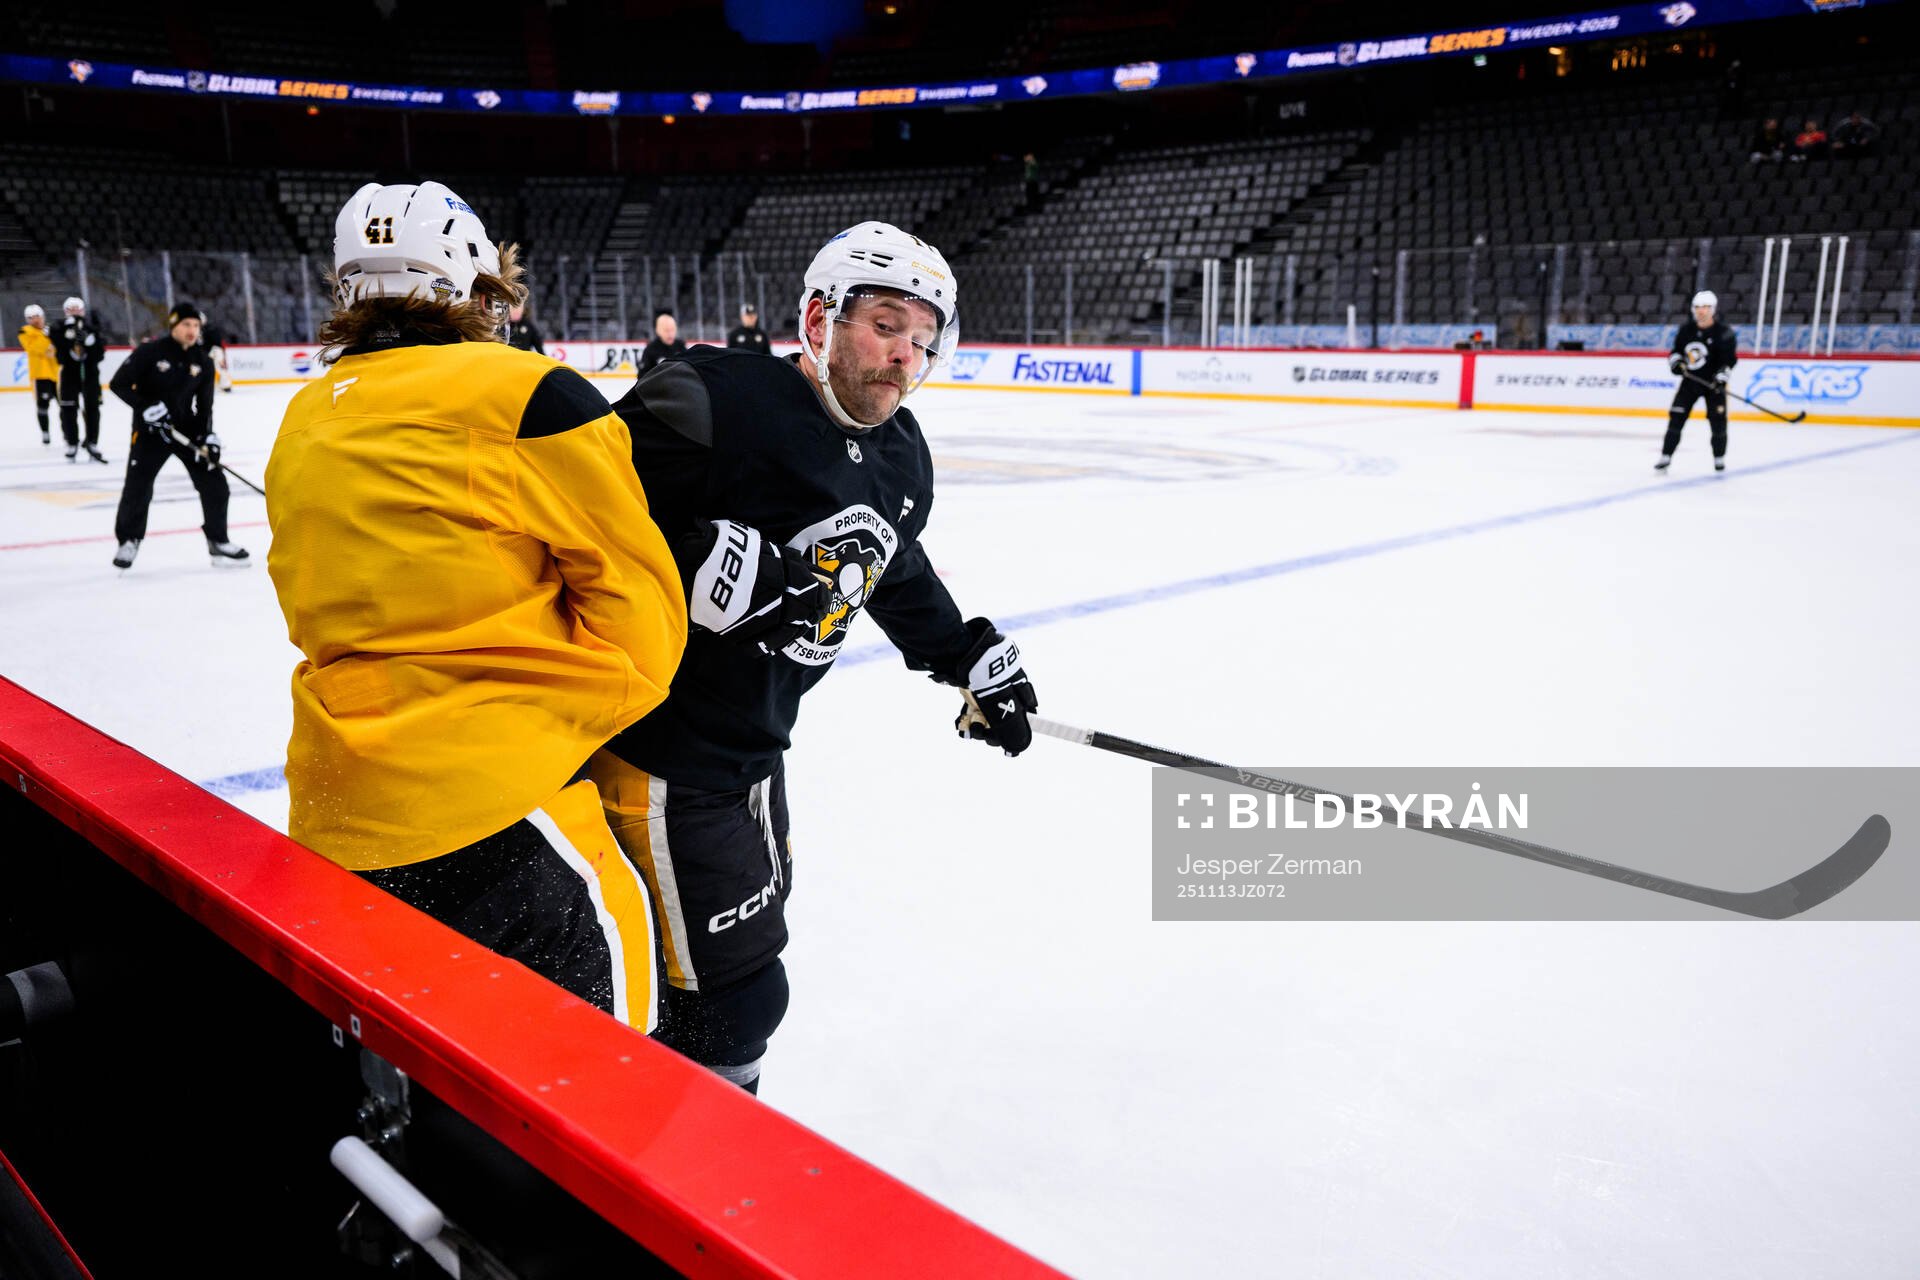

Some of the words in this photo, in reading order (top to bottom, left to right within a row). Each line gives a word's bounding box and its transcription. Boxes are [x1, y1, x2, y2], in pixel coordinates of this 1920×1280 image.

[1356, 37, 1427, 63] GLOBAL
[1428, 28, 1507, 54] SERIES
[208, 74, 277, 95] GLOBAL
[279, 80, 348, 99] SERIES
[365, 217, 394, 244] 41
[1013, 353, 1114, 384] FASTENAL
[1309, 366, 1369, 383] GLOBAL
[1373, 368, 1439, 384] SERIES
[1496, 374, 1567, 387] SWEDEN
[1574, 376, 1620, 388] 2025
[835, 511, 880, 531] PROPERTY
[881, 528, 893, 544] OF
[708, 877, 778, 934] CCM
